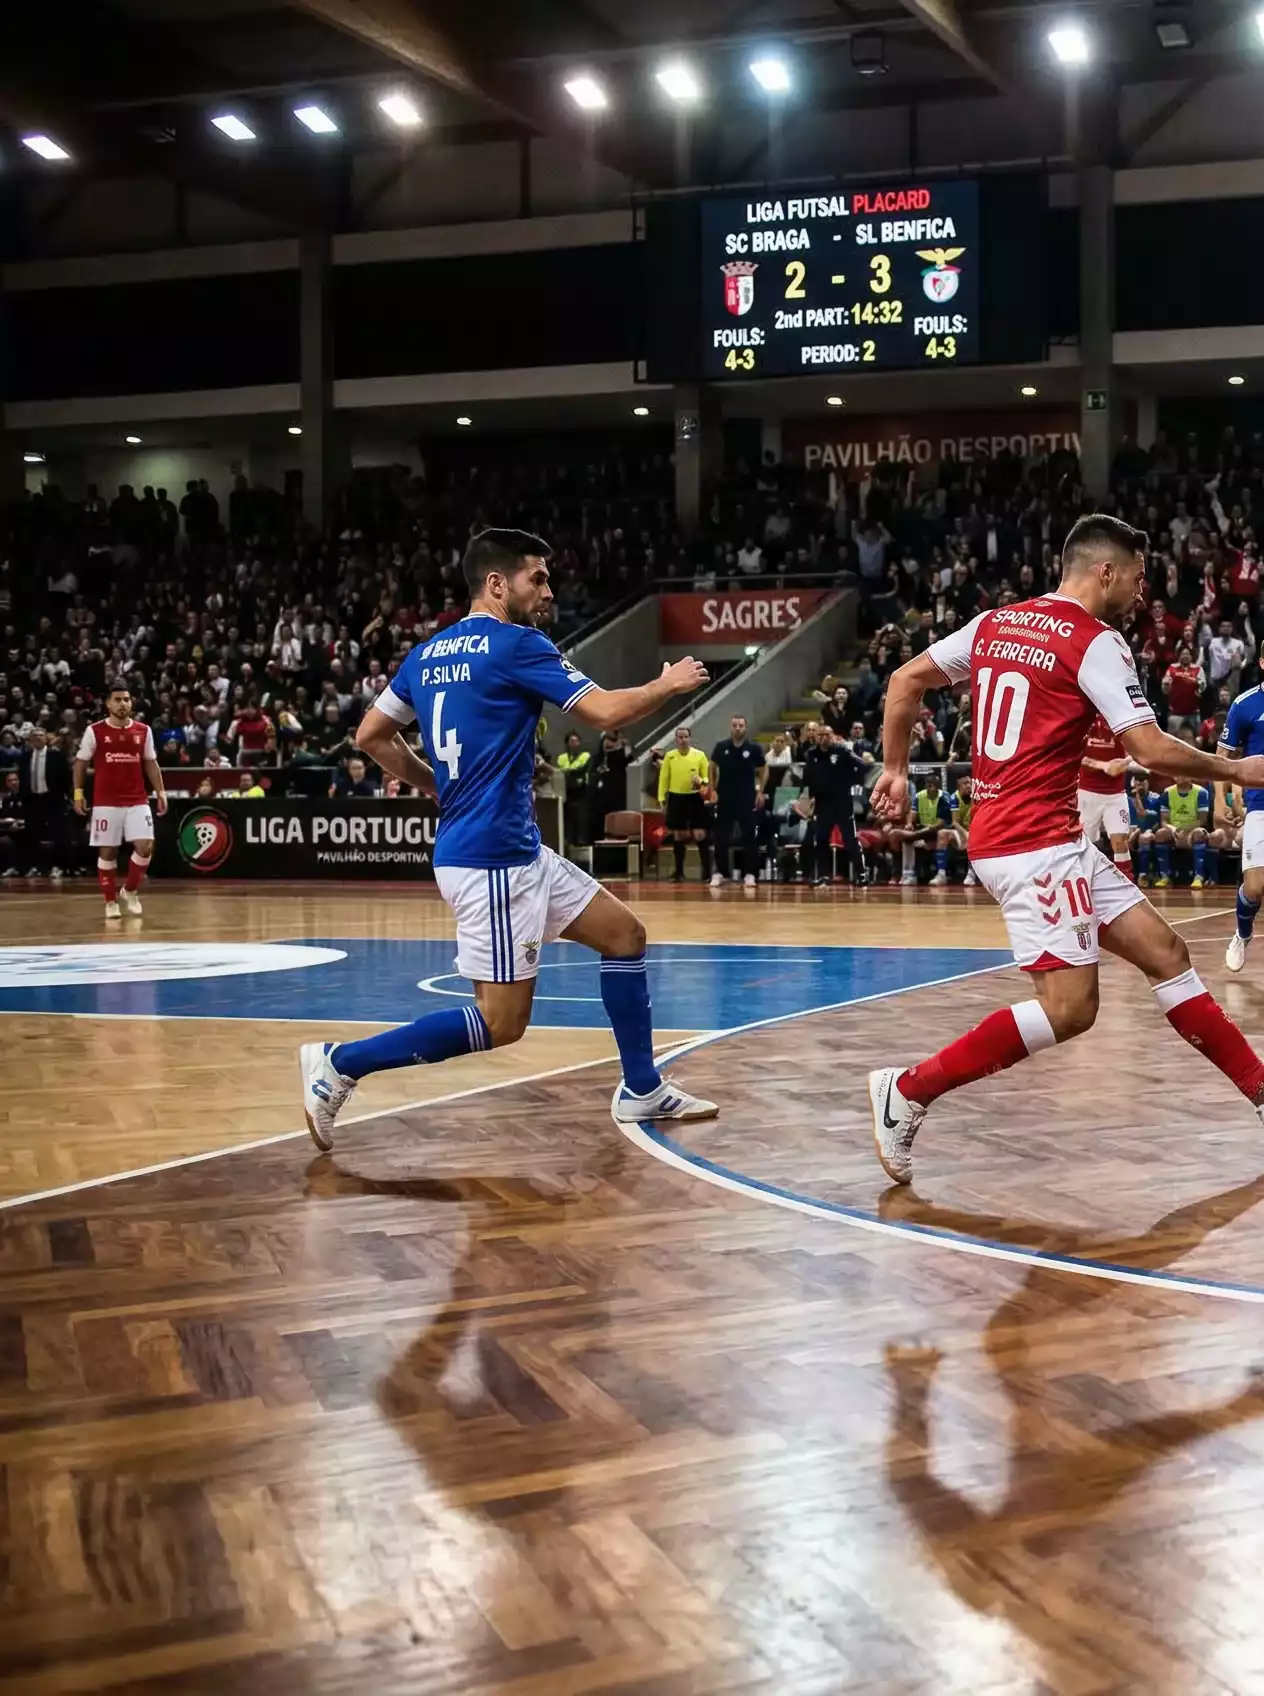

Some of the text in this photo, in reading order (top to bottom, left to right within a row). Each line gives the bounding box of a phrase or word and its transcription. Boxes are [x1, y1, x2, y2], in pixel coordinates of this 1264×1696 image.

[747, 189, 930, 223] LIGA FUTSAL PLACARD
[725, 233, 748, 254] SC
[752, 229, 810, 251] BRAGA
[856, 223, 877, 244] SL
[881, 217, 955, 242] BENFICA
[785, 261, 806, 298] 2
[869, 255, 891, 293] 3
[775, 301, 902, 329] 2nd PART: 14:32
[914, 316, 968, 335] FOULS:
[714, 330, 765, 348] FOULS:
[802, 341, 875, 364] PERIOD: 2
[925, 338, 956, 359] 4-3
[725, 350, 755, 370] 4-3
[804, 434, 932, 469] PAVILHÃO
[702, 597, 802, 633] SAGRES
[992, 610, 1074, 637] SPORTING
[975, 638, 1056, 671] G. FERREIRA
[422, 663, 471, 686] P.SILVA
[977, 667, 1029, 761] 10
[432, 691, 462, 780] 4
[96, 820, 108, 831] 10
[246, 816, 436, 845] LIGA PORTUGU
[368, 851, 429, 863] DESPORTIVA
[1061, 877, 1093, 917] 10
